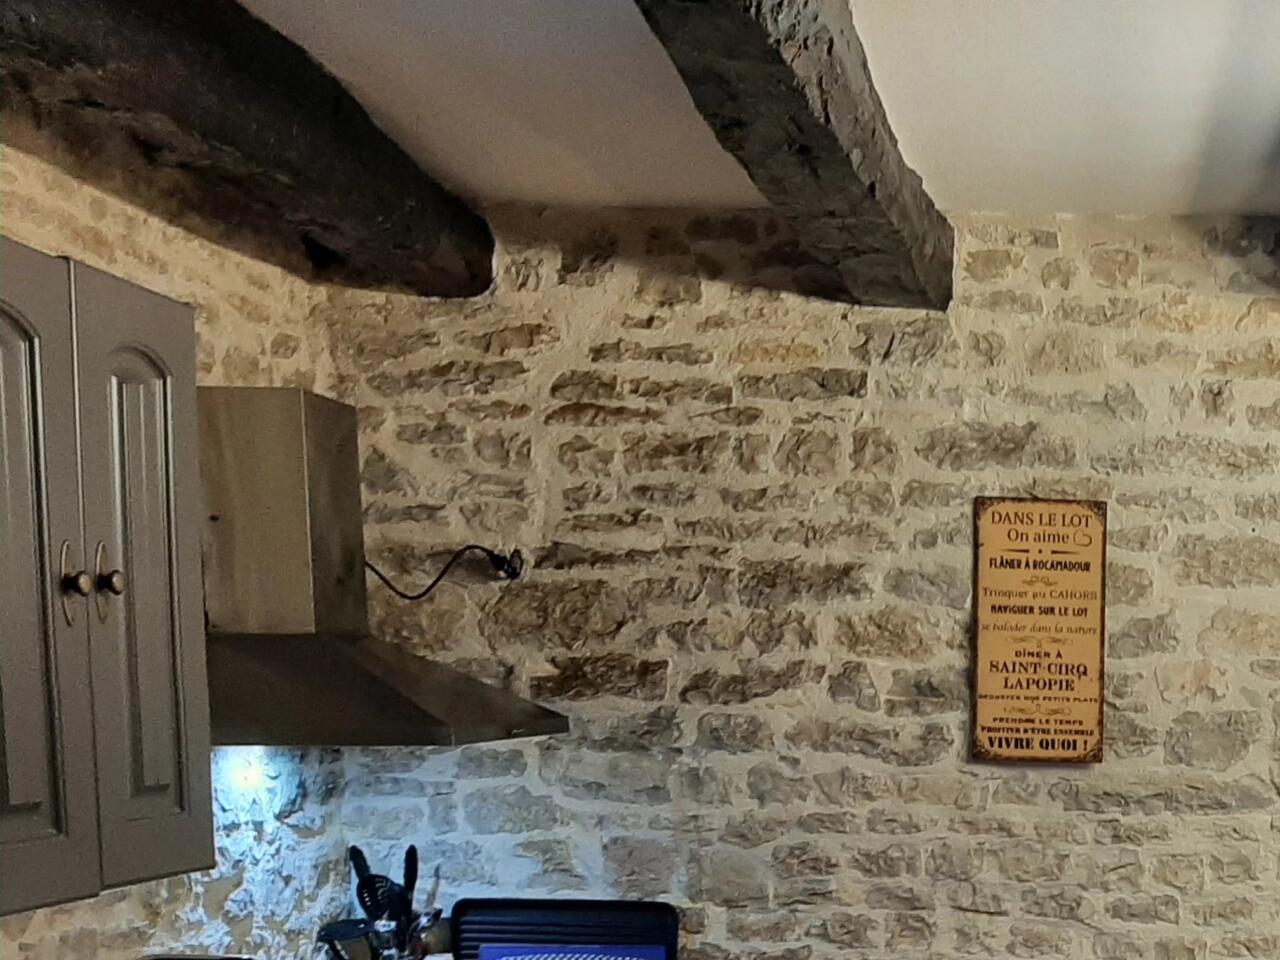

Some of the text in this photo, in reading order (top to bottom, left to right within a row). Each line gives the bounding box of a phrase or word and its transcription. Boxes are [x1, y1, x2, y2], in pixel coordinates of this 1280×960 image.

[991, 511, 1092, 528] DANS LE LOT
[1007, 528, 1070, 544] On aime
[989, 555, 1022, 570] FLÂNER
[1033, 560, 1091, 572] ROCAMADOUR
[983, 587, 1028, 600] Trinquer
[1049, 589, 1098, 601] CAHORS
[1038, 605, 1055, 616] SUR
[1059, 606, 1068, 616] LE
[1072, 606, 1088, 617] LOT
[992, 621, 1027, 631] balader
[1030, 622, 1051, 634] dans
[1054, 624, 1064, 634] la
[1003, 677, 1075, 692] LAPOPIE
[992, 717, 1036, 725] PRENDRE
[1053, 718, 1084, 726] TEMPS
[1054, 727, 1095, 736] ENSEMBLE
[987, 736, 1034, 750] VIVRE
[1039, 737, 1078, 751] QUOI
